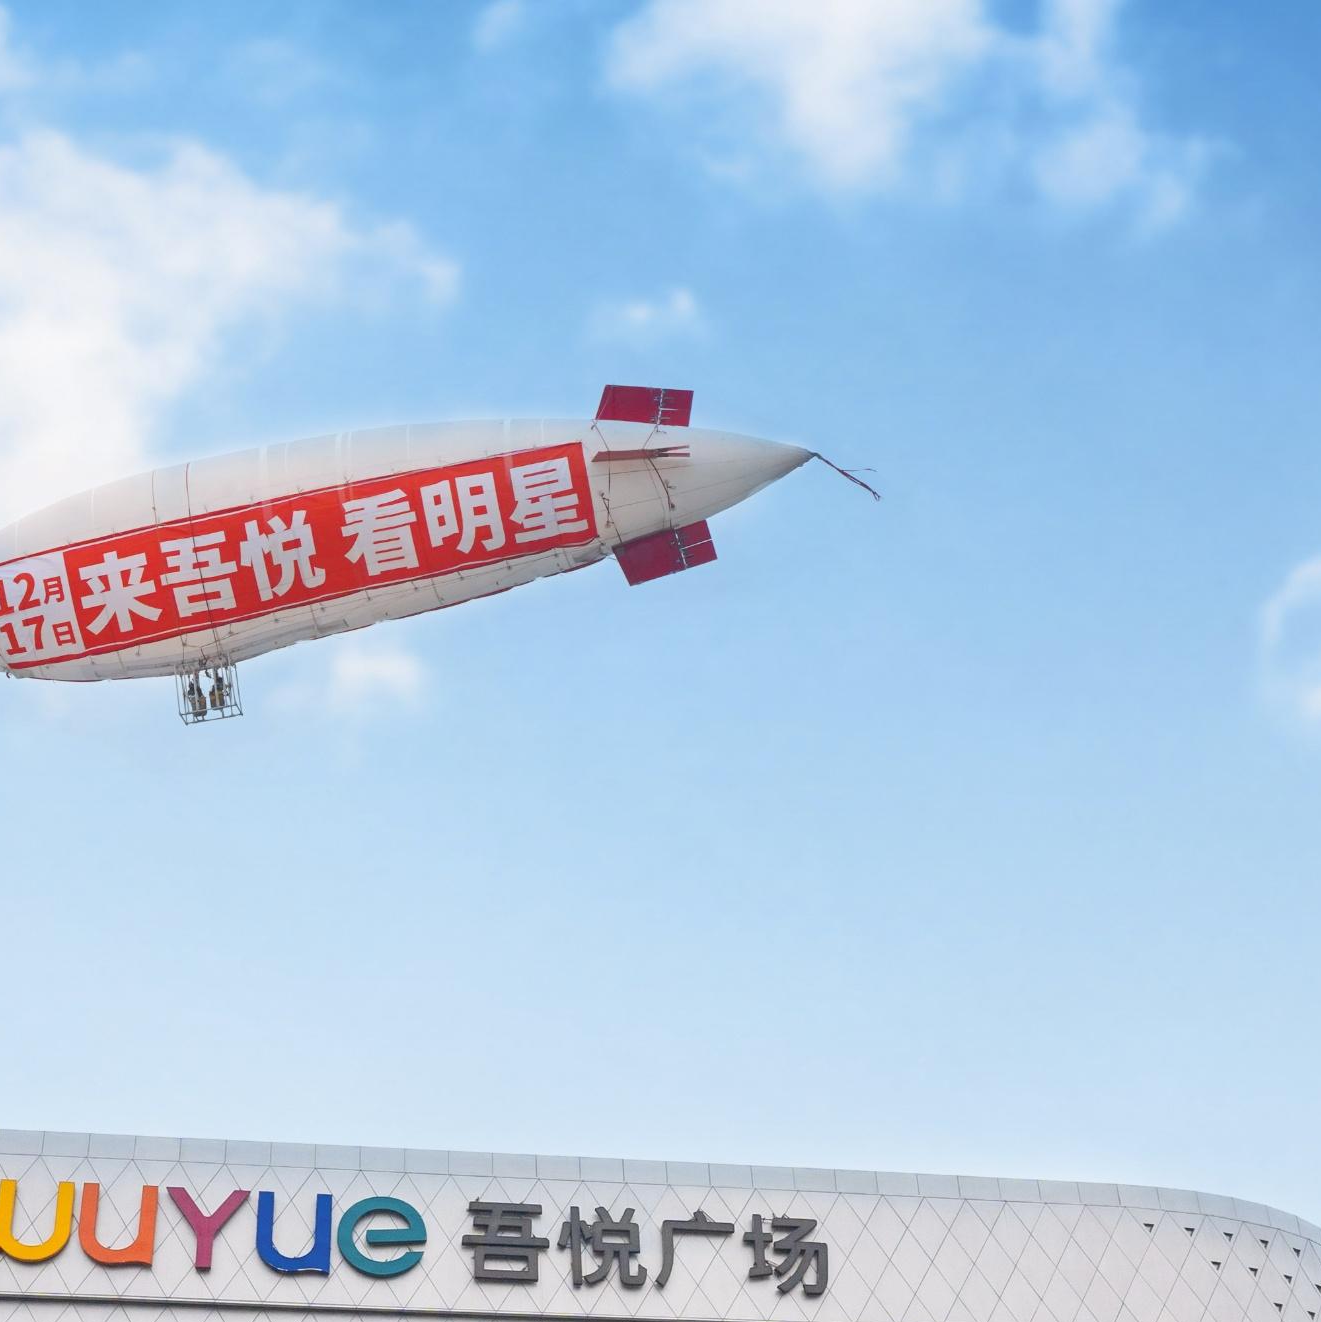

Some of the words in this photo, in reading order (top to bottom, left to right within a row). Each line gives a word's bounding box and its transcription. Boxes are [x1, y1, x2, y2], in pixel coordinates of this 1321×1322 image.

[79, 516, 326, 637] 来吾悦
[342, 457, 595, 577] 看明星
[0, 615, 76, 655] 17日
[462, 1199, 828, 1296] 吾悦广场
